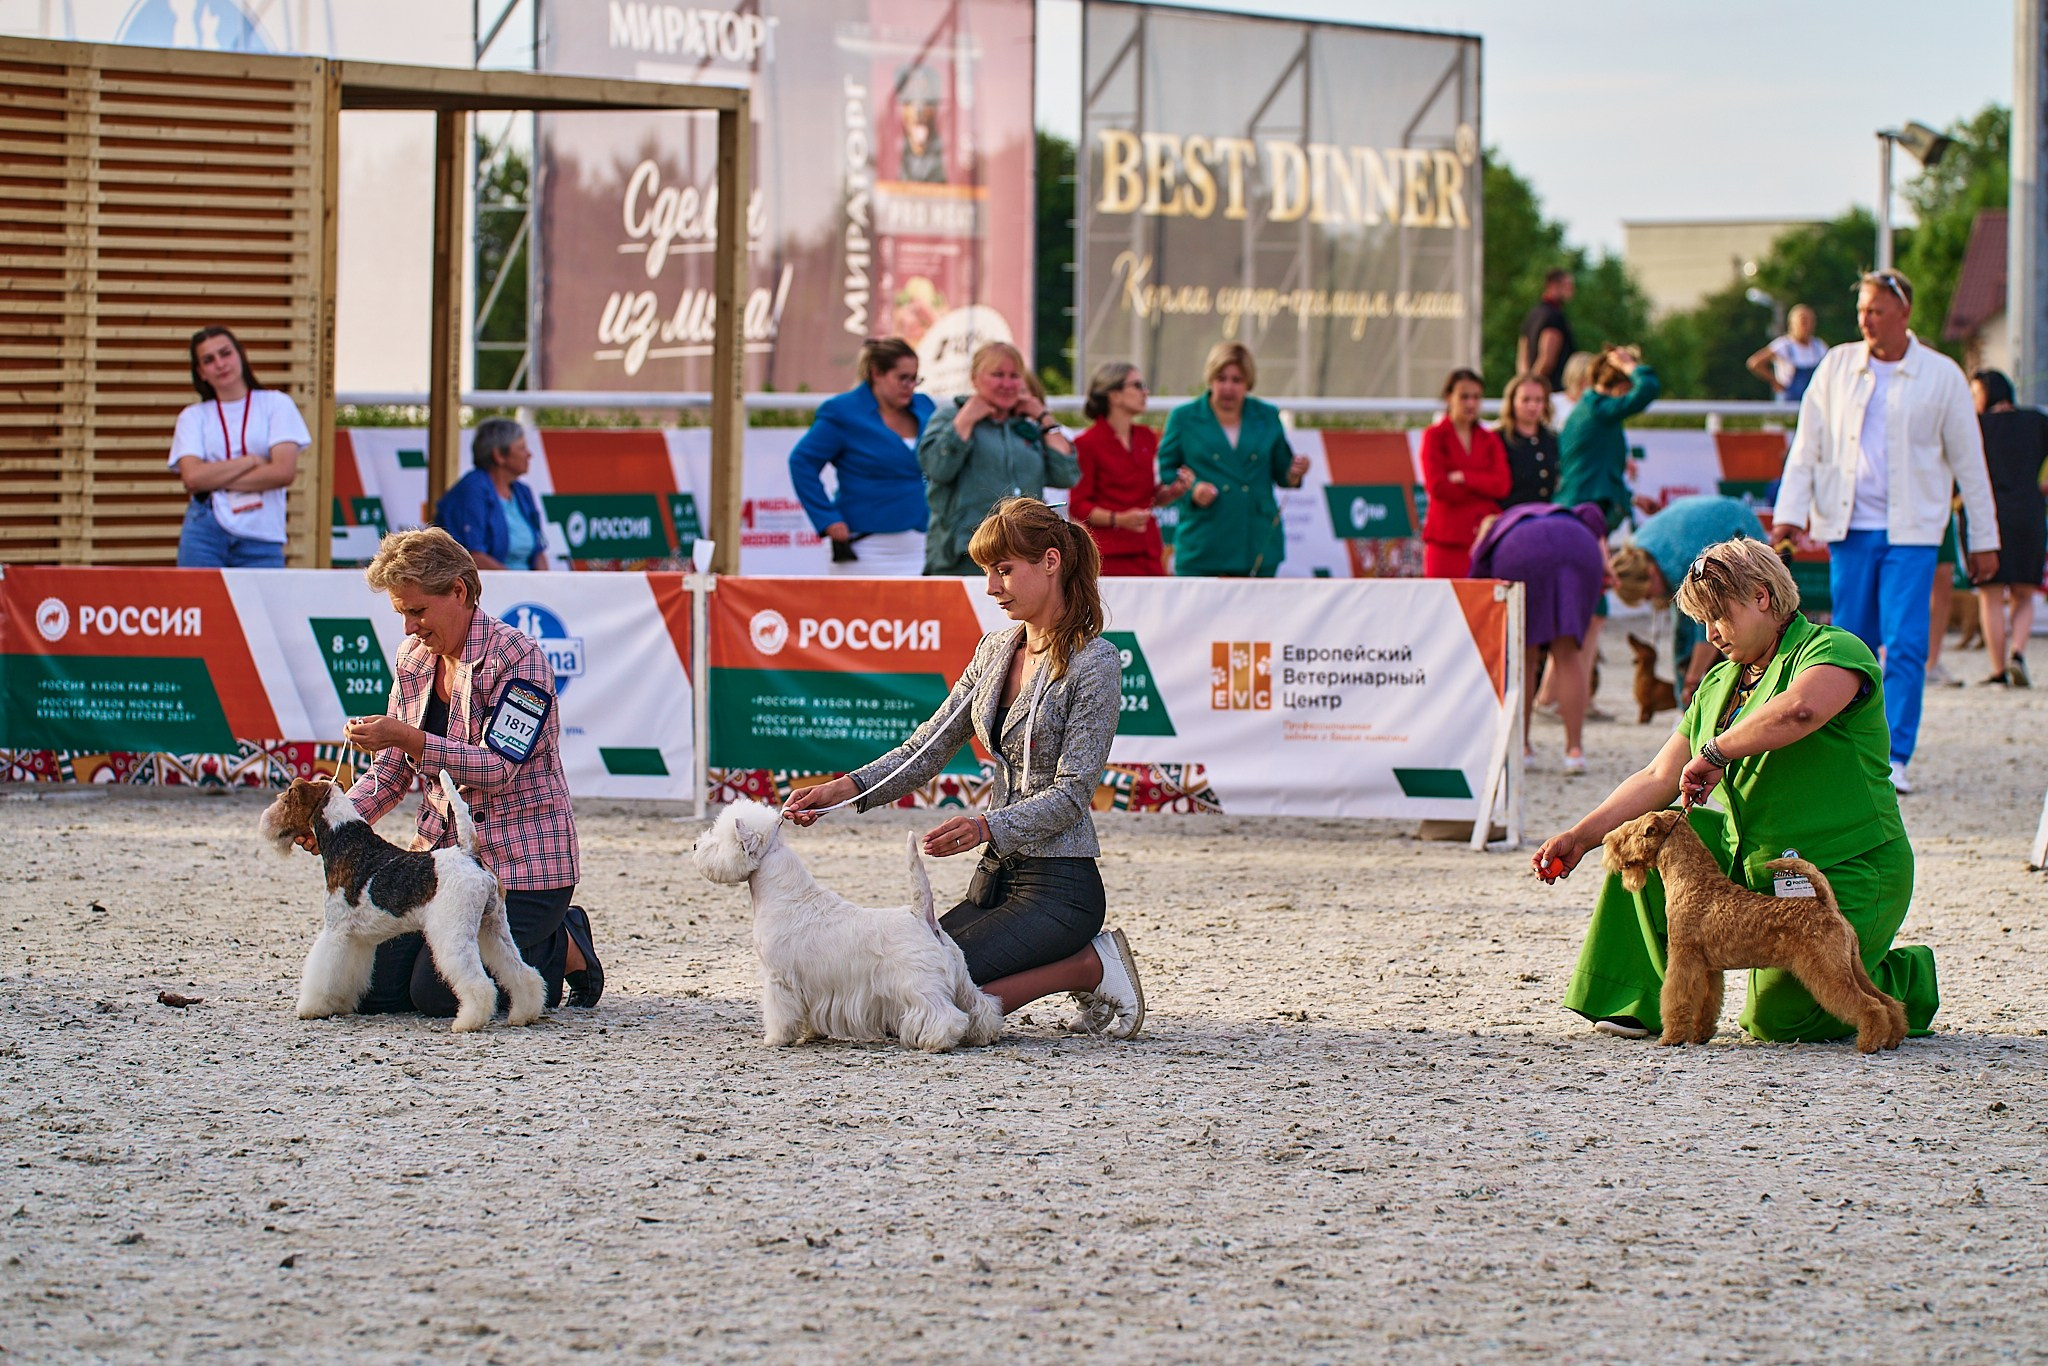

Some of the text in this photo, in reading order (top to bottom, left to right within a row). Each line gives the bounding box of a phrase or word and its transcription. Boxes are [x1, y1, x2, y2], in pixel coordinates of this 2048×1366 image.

[608, 1, 780, 64] МИРАТОРГ
[1097, 129, 1257, 220] BEST
[843, 73, 871, 336] МИРАТОРГ
[589, 516, 652, 540] РОССИЯ
[79, 605, 202, 637] РОССИЯ
[798, 618, 941, 650] РОССИЯ
[1283, 644, 1413, 663] Европейский
[332, 658, 381, 673] ИЮНЯ
[346, 678, 383, 694] 2024
[1283, 668, 1426, 687] Ветеринарный
[1283, 693, 1342, 711] Центр
[504, 714, 535, 737] 1817
